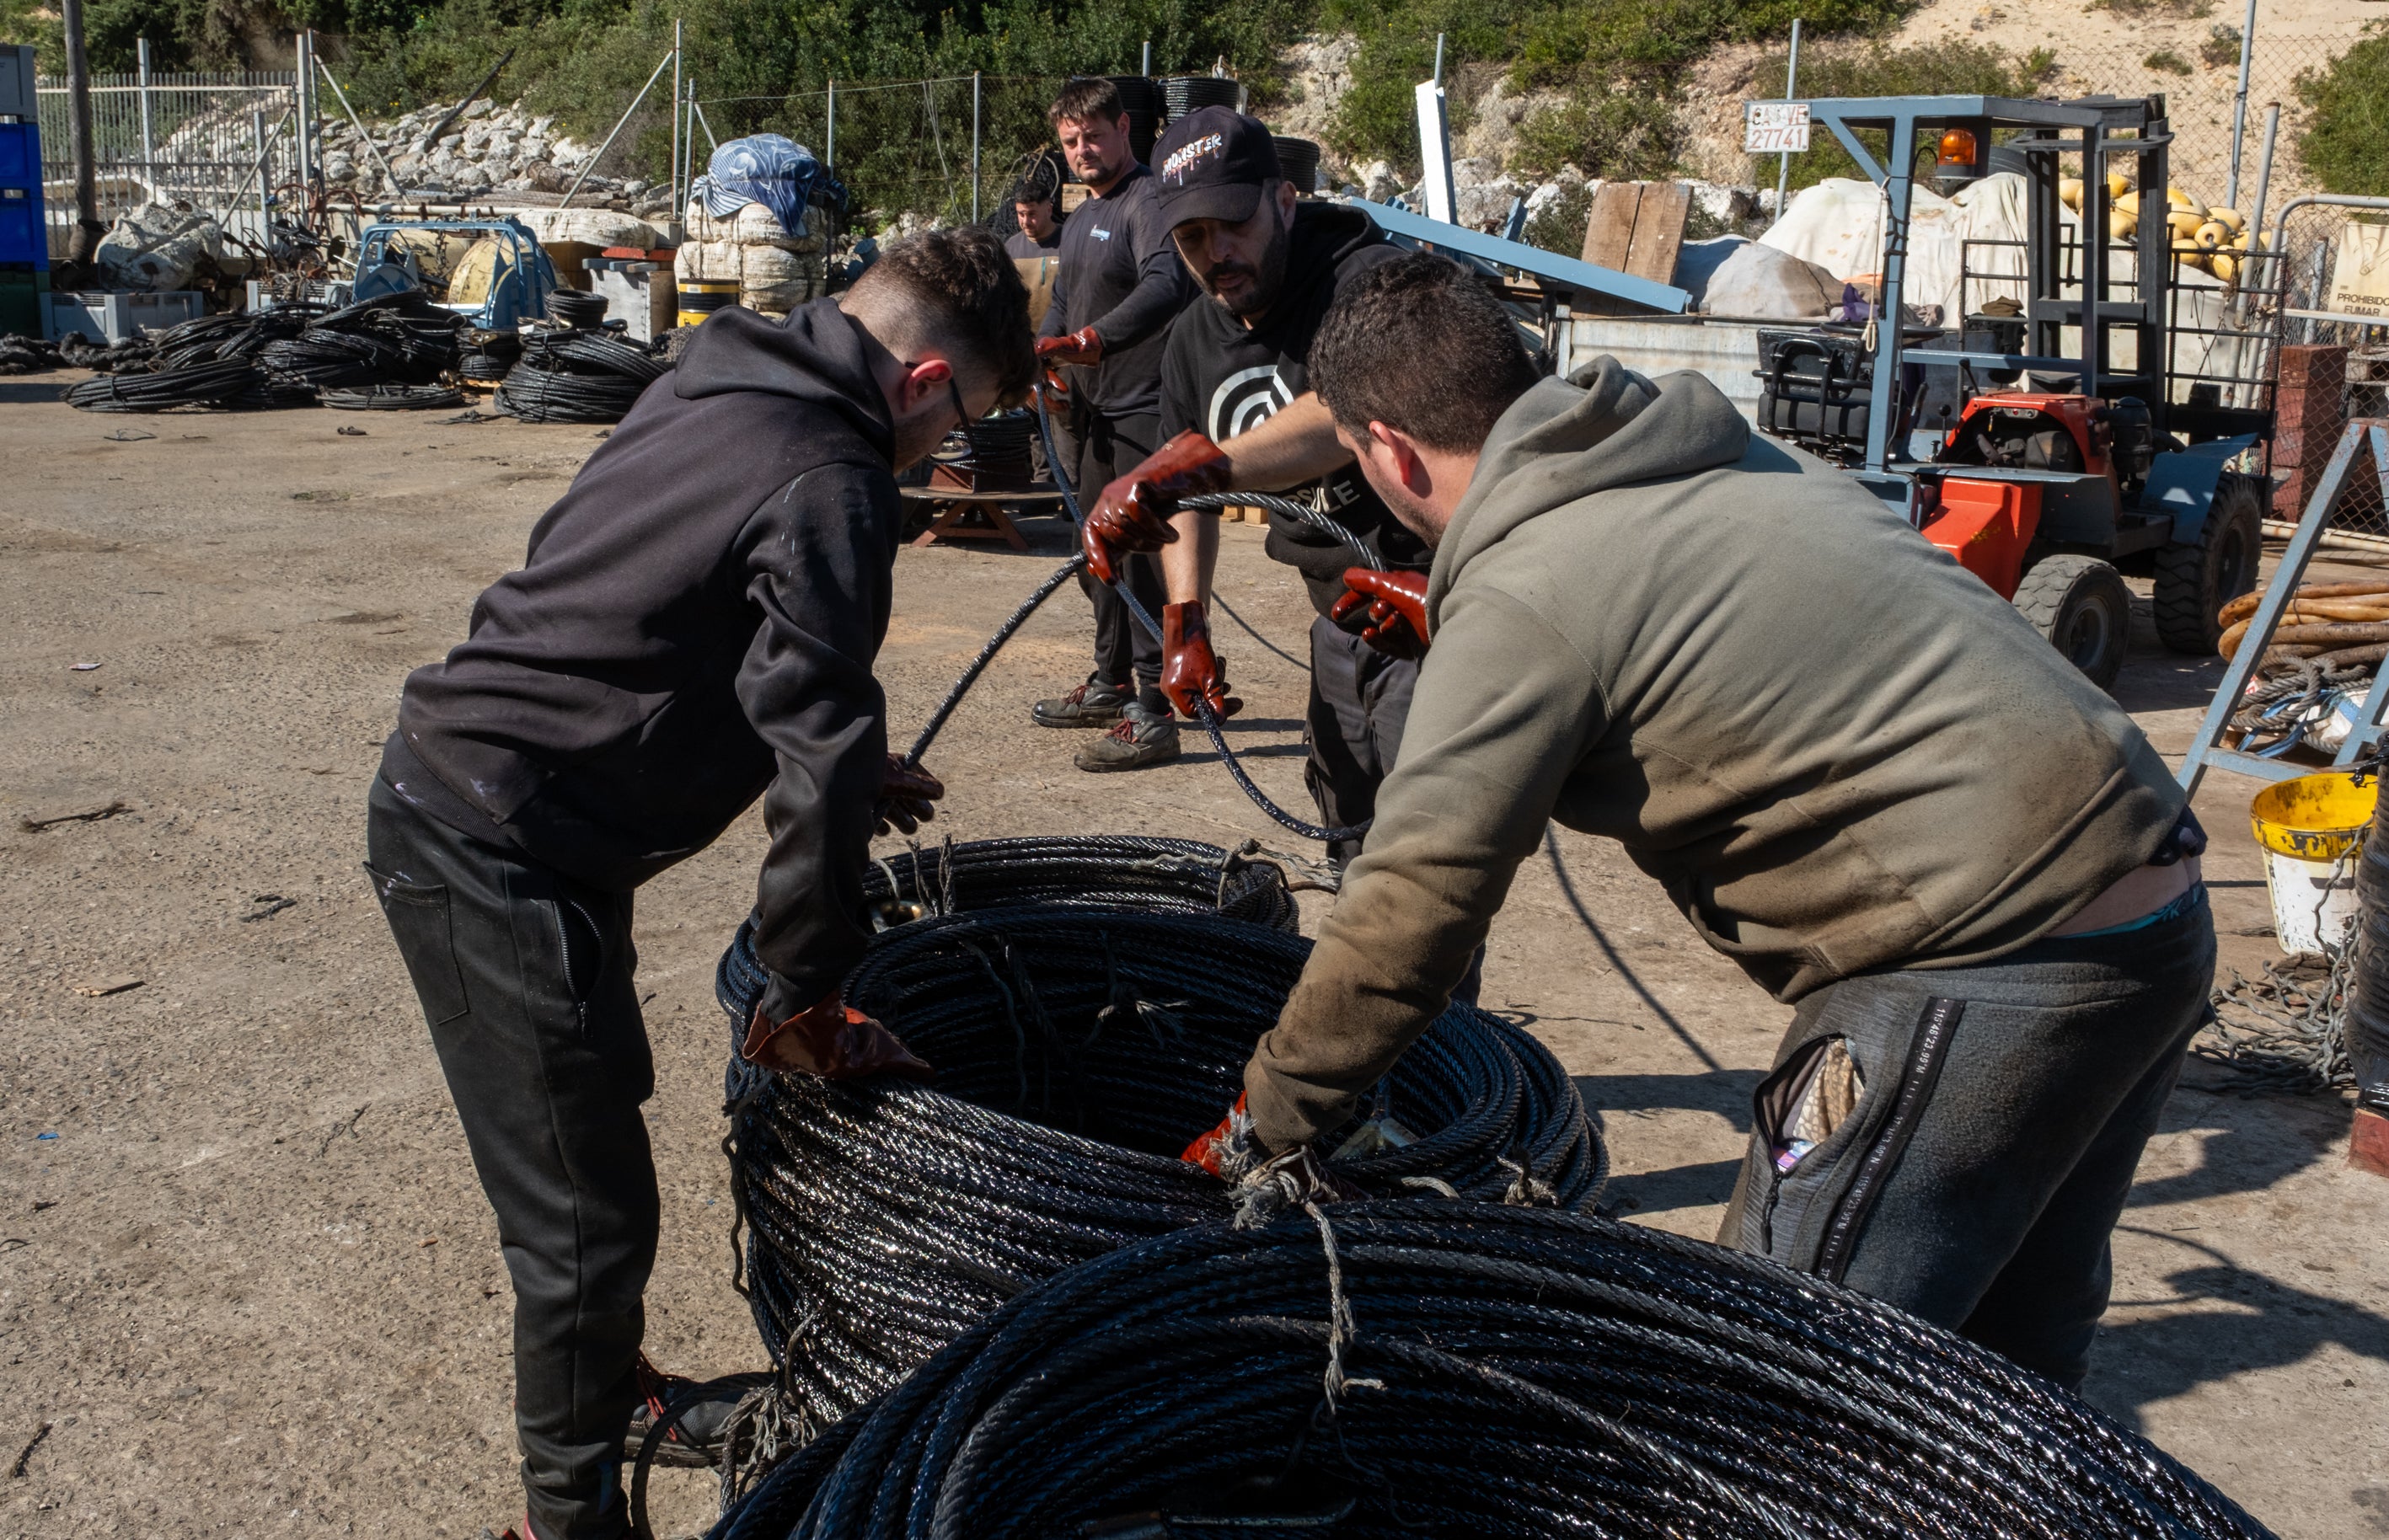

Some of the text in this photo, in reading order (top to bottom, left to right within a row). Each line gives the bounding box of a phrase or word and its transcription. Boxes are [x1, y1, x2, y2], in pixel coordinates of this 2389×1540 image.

[1749, 128, 1803, 148] 27741
[1162, 132, 1222, 177] MONSTER
[2337, 292, 2389, 307] PROHIBIDO
[2343, 305, 2381, 317] FUMAR
